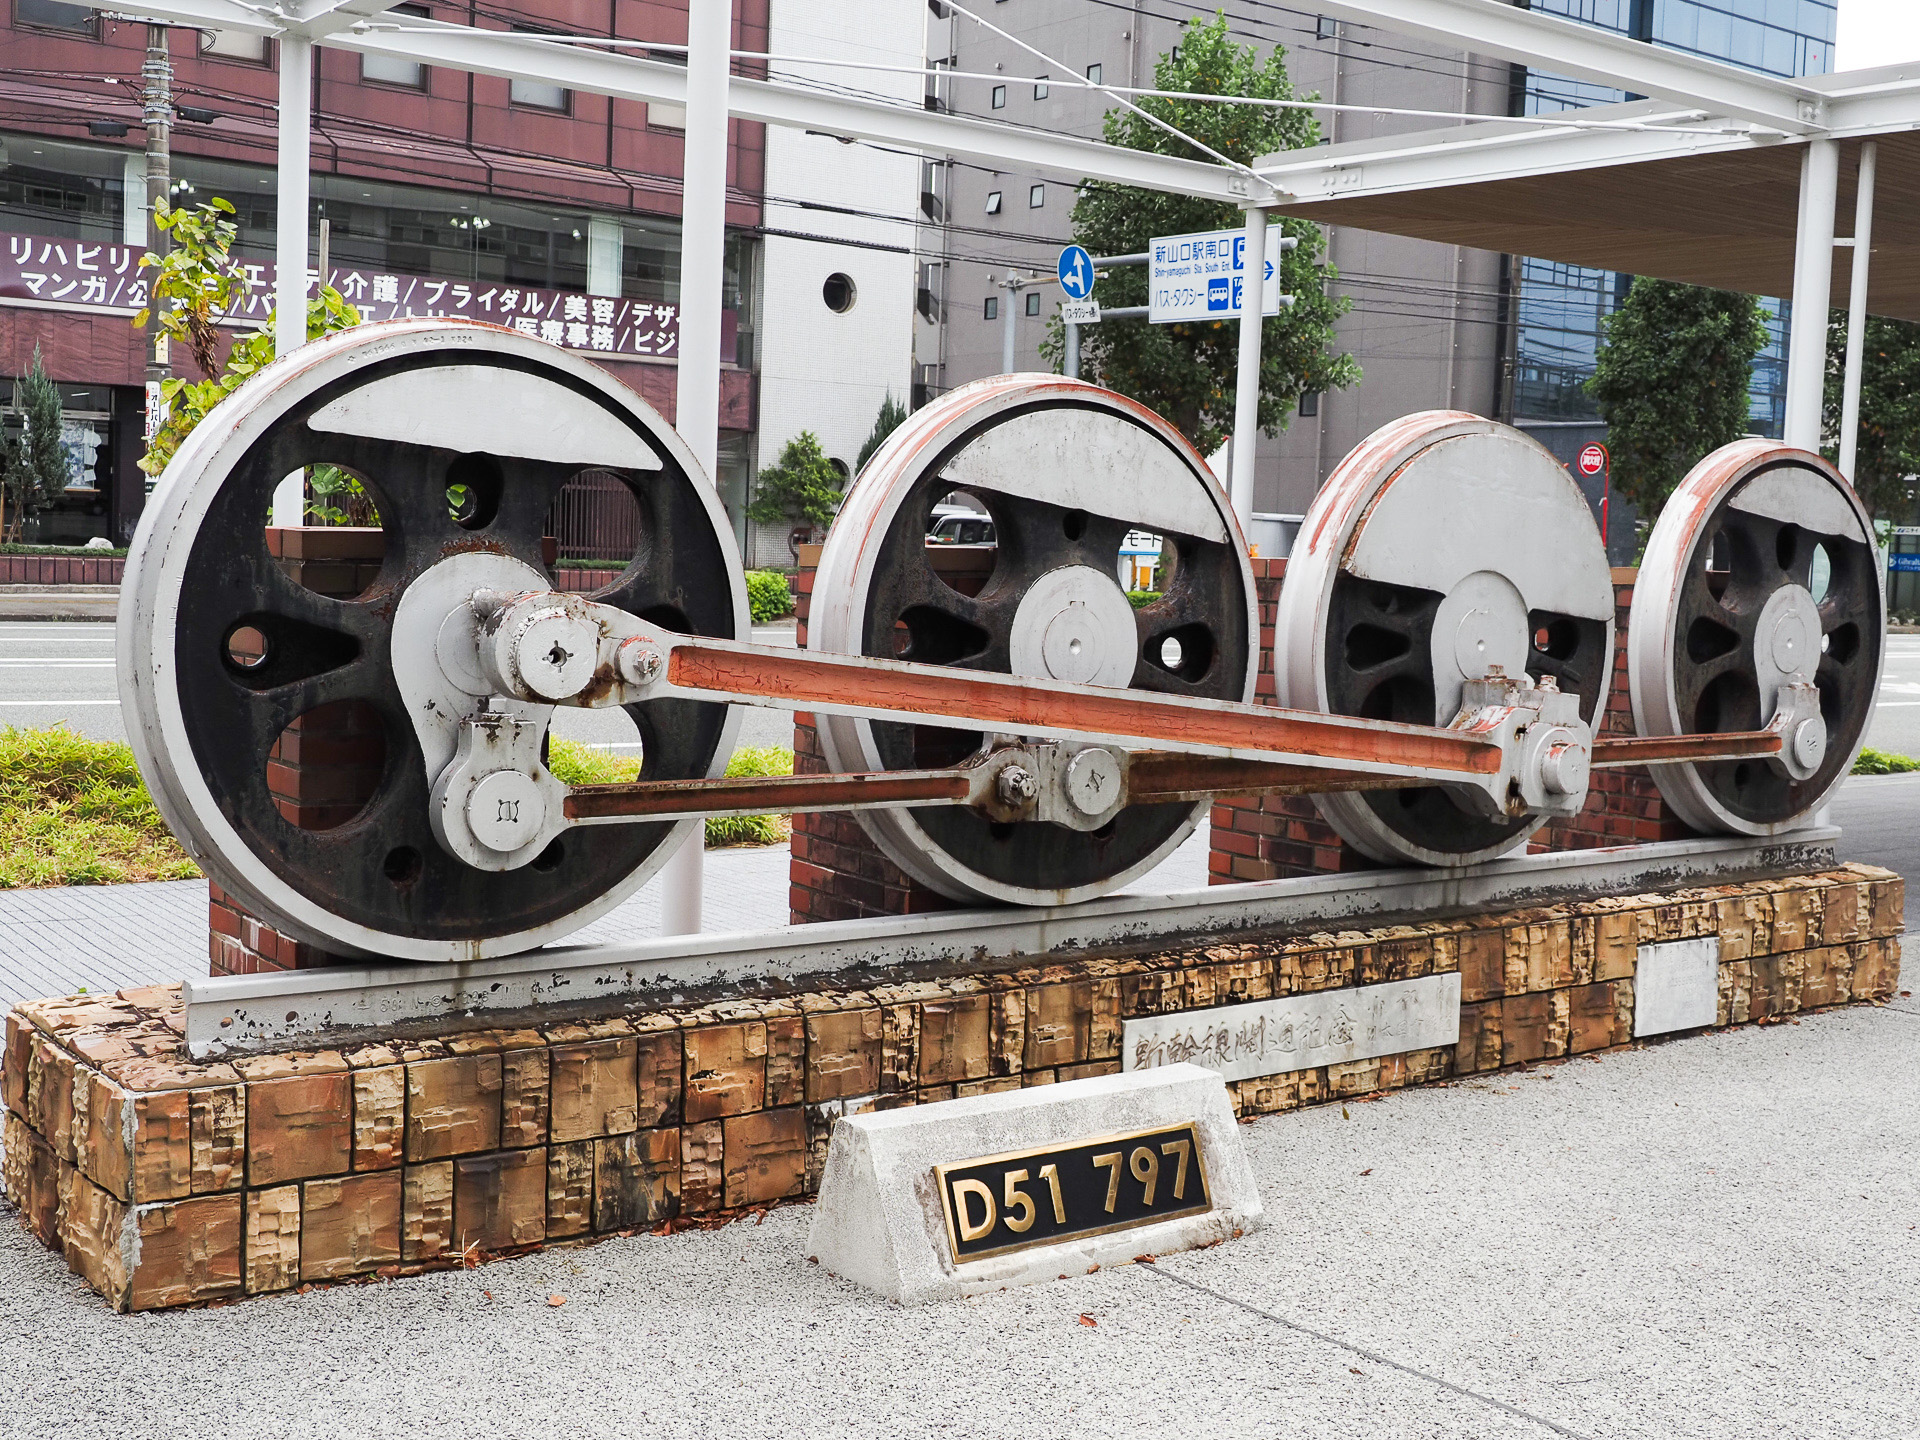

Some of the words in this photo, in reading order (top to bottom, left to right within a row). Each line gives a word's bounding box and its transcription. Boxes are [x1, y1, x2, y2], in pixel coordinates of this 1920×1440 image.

[1155, 239, 1229, 264] 新山口駅南口
[1155, 265, 1191, 279] Shin-yamaguchi
[1205, 262, 1219, 274] South
[1154, 288, 1205, 308] バス・タクシー
[951, 1163, 1066, 1243] D51
[1093, 1138, 1191, 1214] 797
